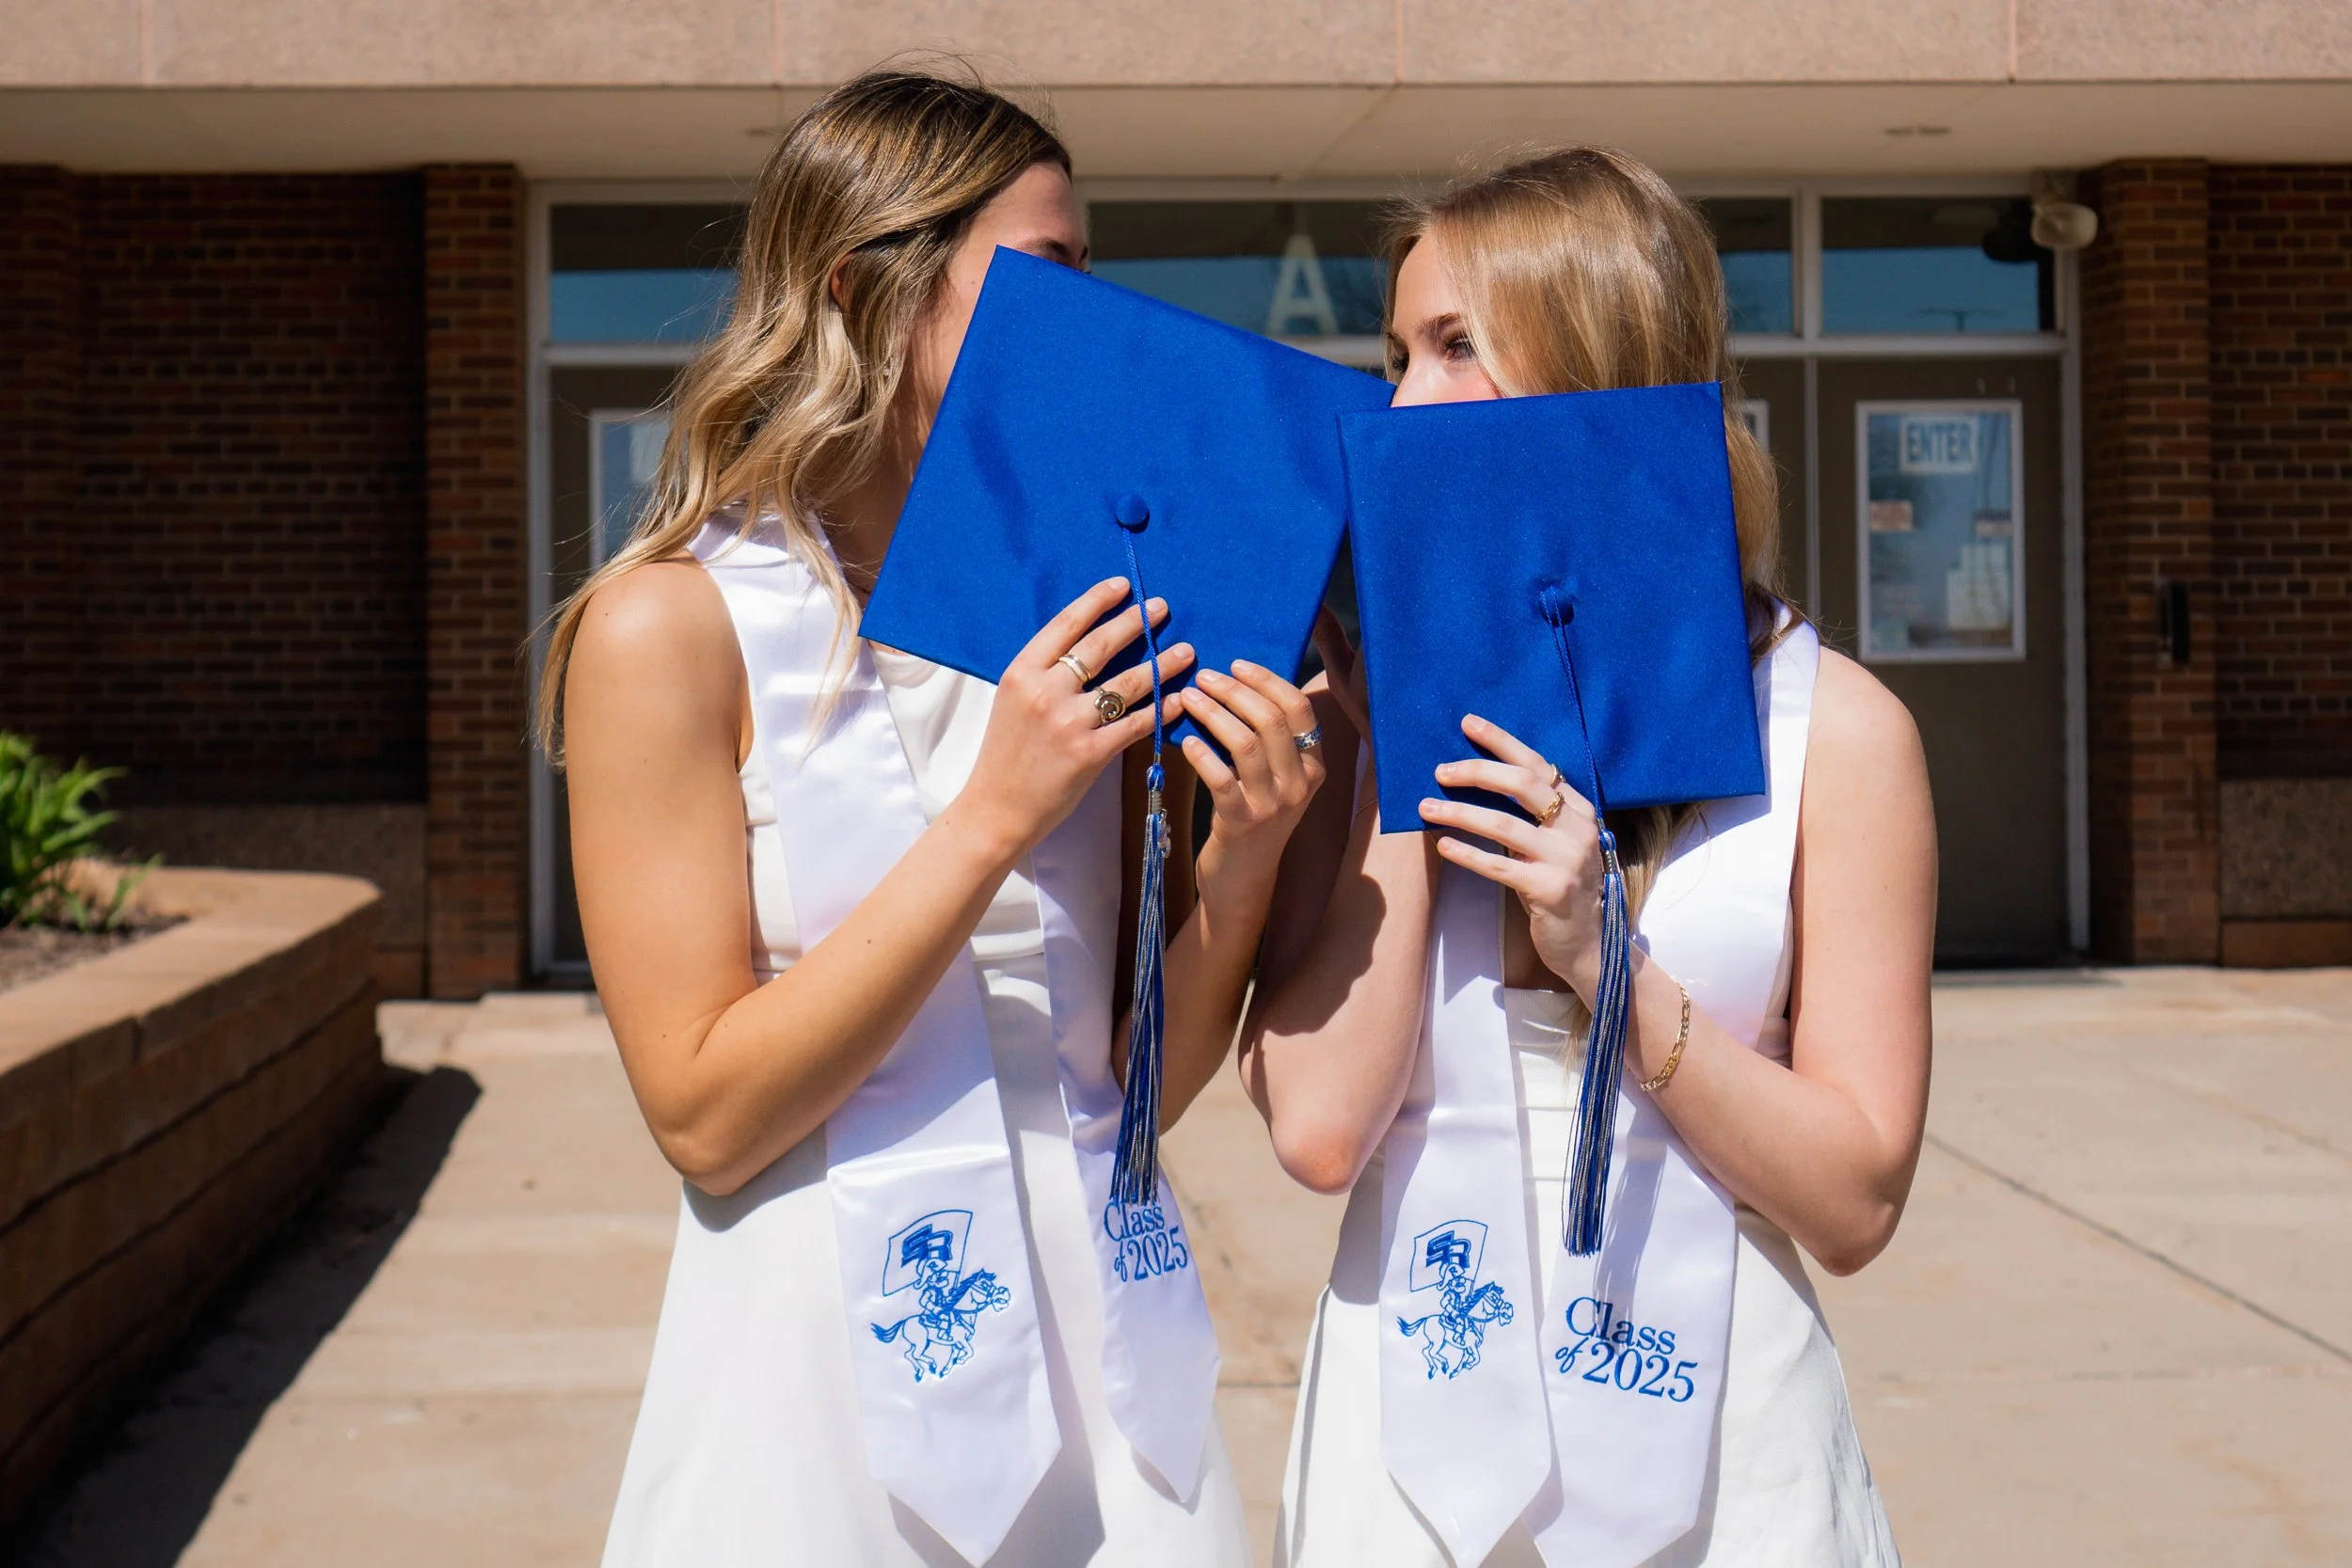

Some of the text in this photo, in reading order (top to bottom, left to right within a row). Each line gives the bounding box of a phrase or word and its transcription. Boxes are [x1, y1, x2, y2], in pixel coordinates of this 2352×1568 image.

[1266, 234, 1338, 336] A
[1907, 421, 1971, 463] ENTER
[1104, 1200, 1165, 1242] Class
[1114, 1226, 1187, 1283] of 2025
[1565, 1296, 1677, 1355] Class
[1555, 1337, 1698, 1402] of 2025
